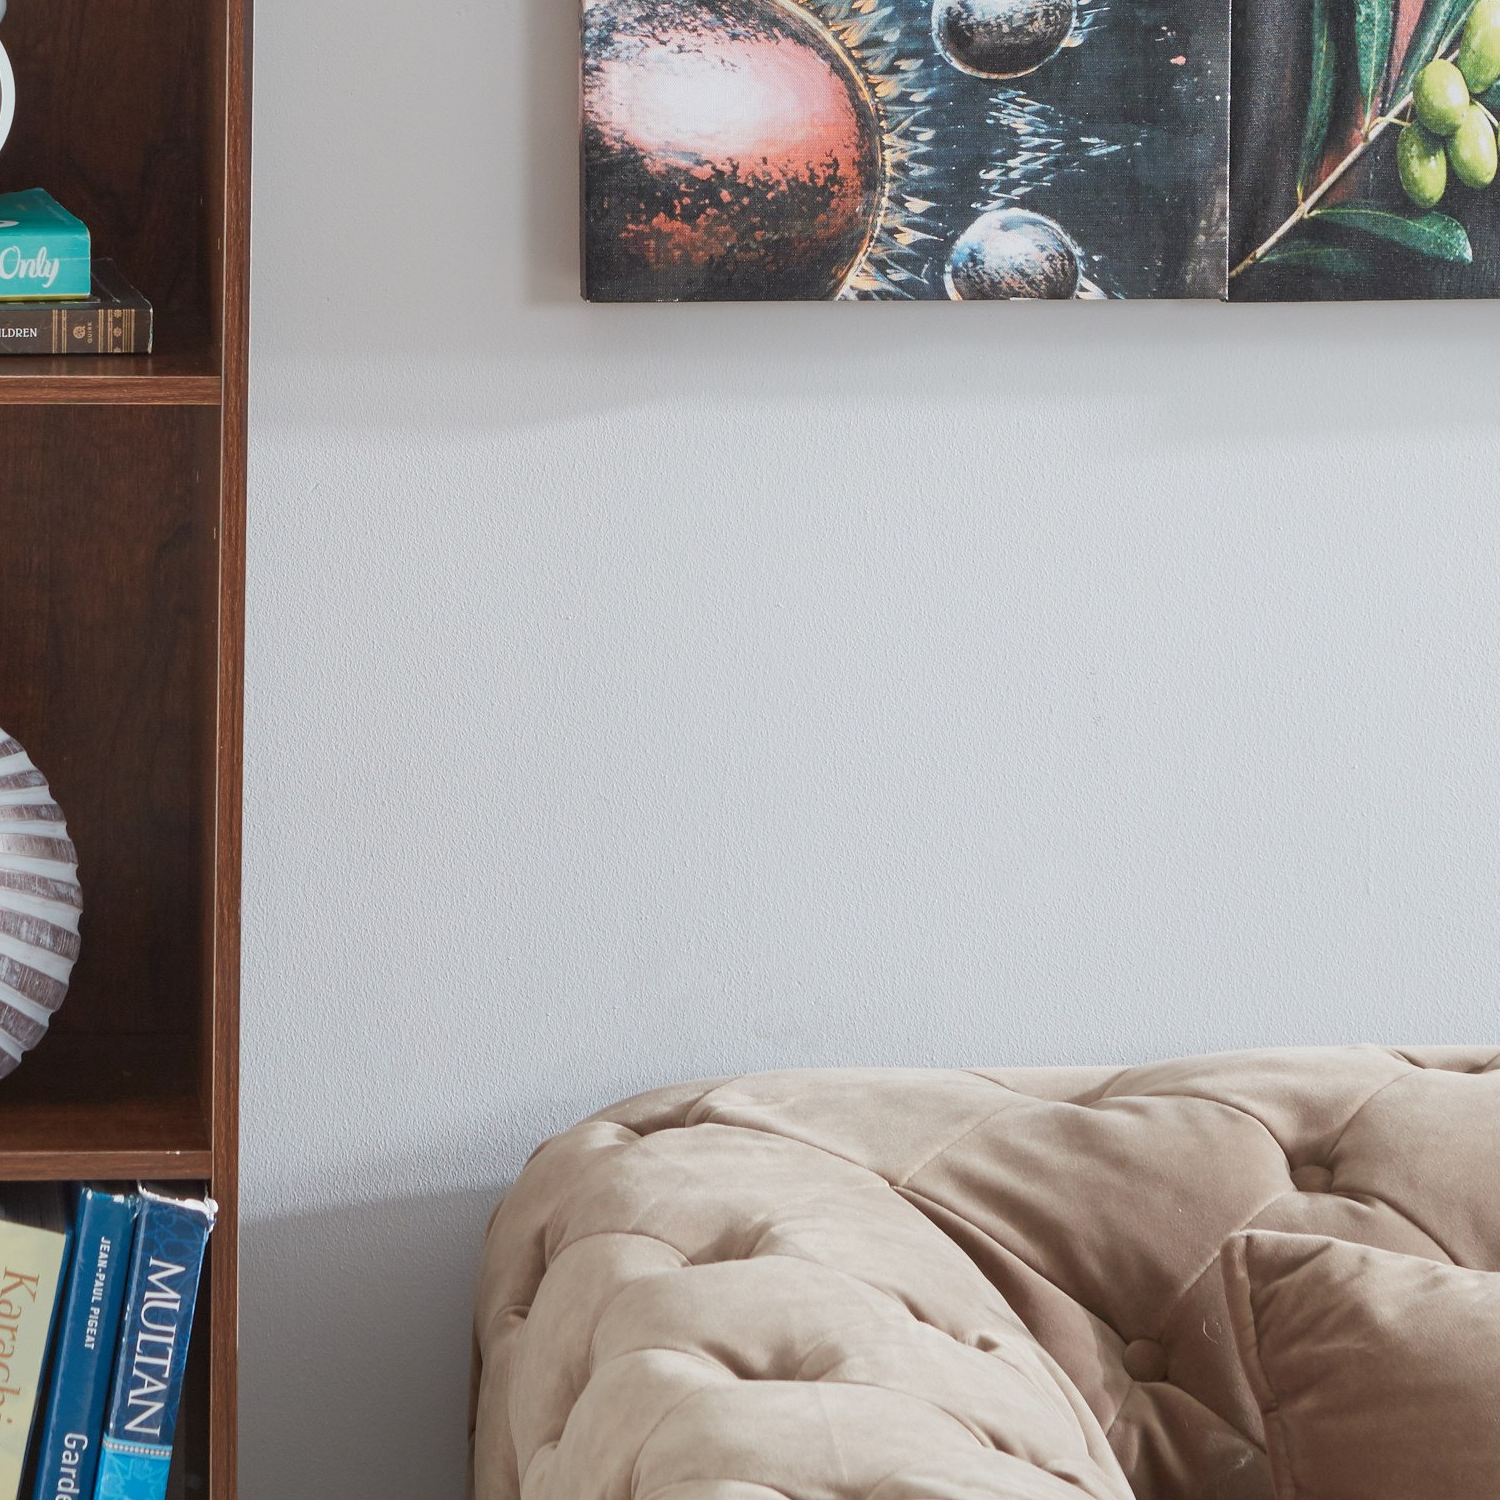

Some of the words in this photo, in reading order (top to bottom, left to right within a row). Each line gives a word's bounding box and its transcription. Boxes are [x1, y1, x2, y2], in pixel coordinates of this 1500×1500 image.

[91, 1236, 111, 1303] JEAN-PAUL
[84, 1306, 100, 1350] PIGEAT
[124, 1256, 186, 1436] MULTAN
